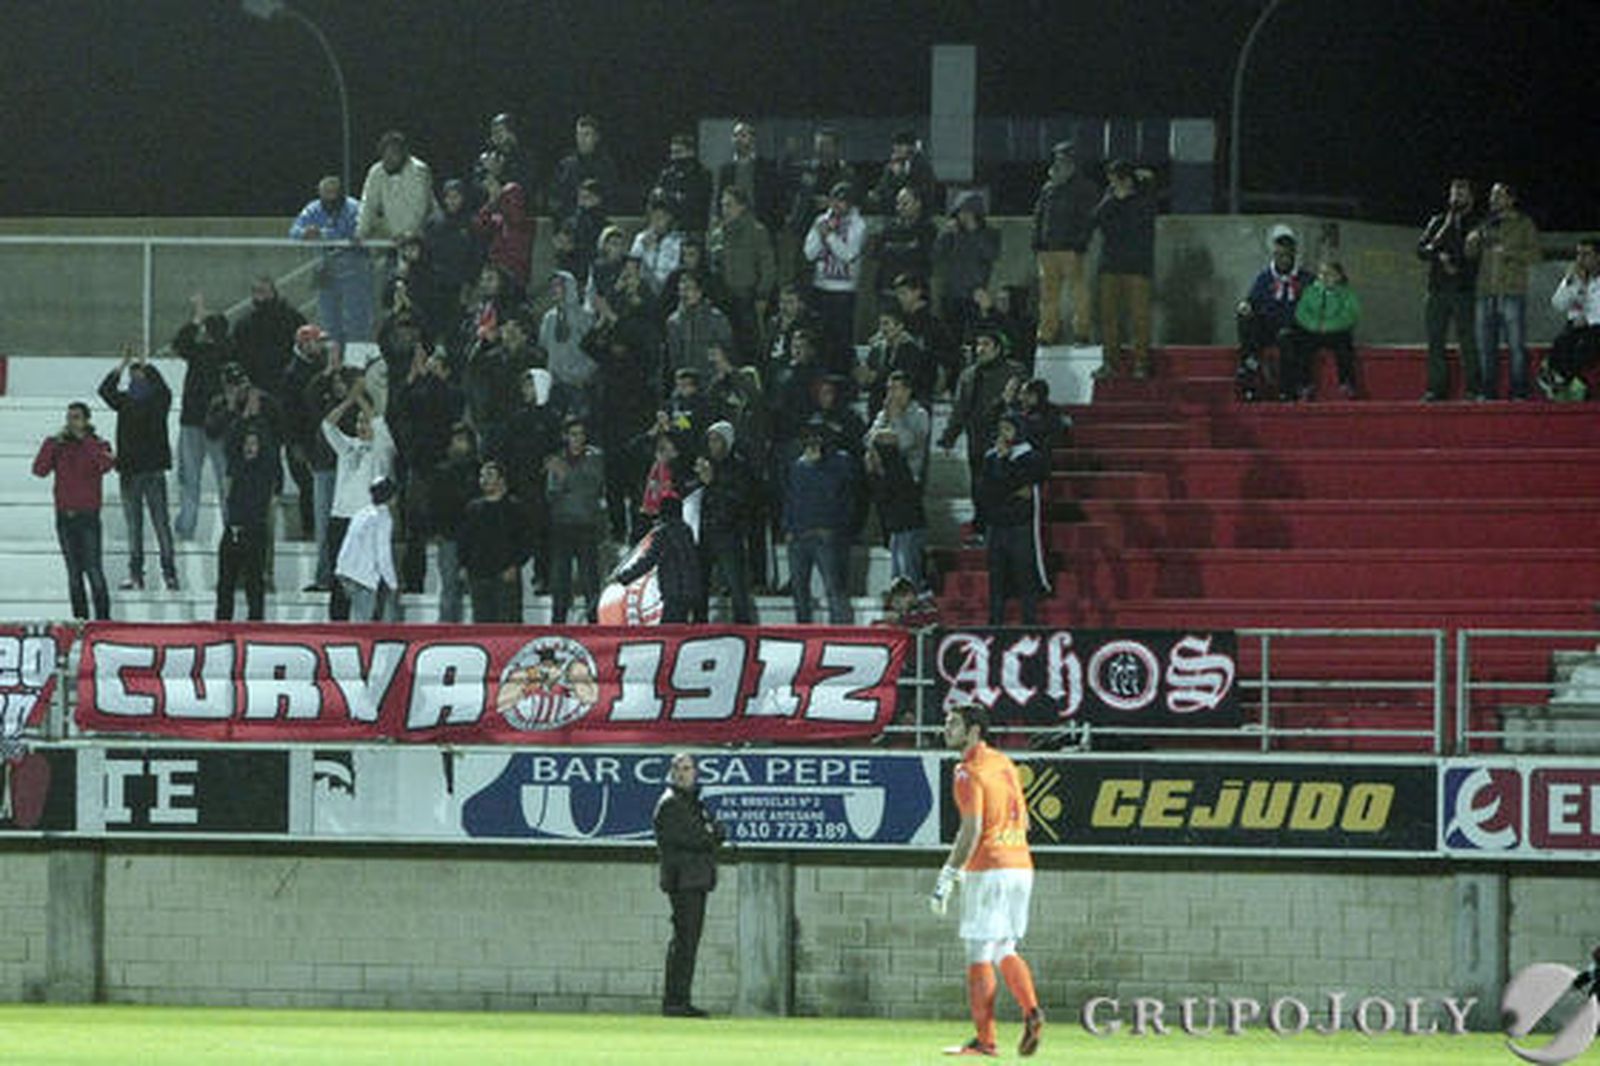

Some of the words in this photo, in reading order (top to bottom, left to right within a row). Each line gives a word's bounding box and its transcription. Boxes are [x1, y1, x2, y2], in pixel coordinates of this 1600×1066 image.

[93, 640, 489, 730] CURVA
[608, 636, 892, 723] 1912
[532, 757, 620, 783] BAR
[766, 759, 872, 784] PEPE
[736, 822, 770, 839] 610
[776, 822, 809, 839] 772
[815, 822, 848, 839] 189
